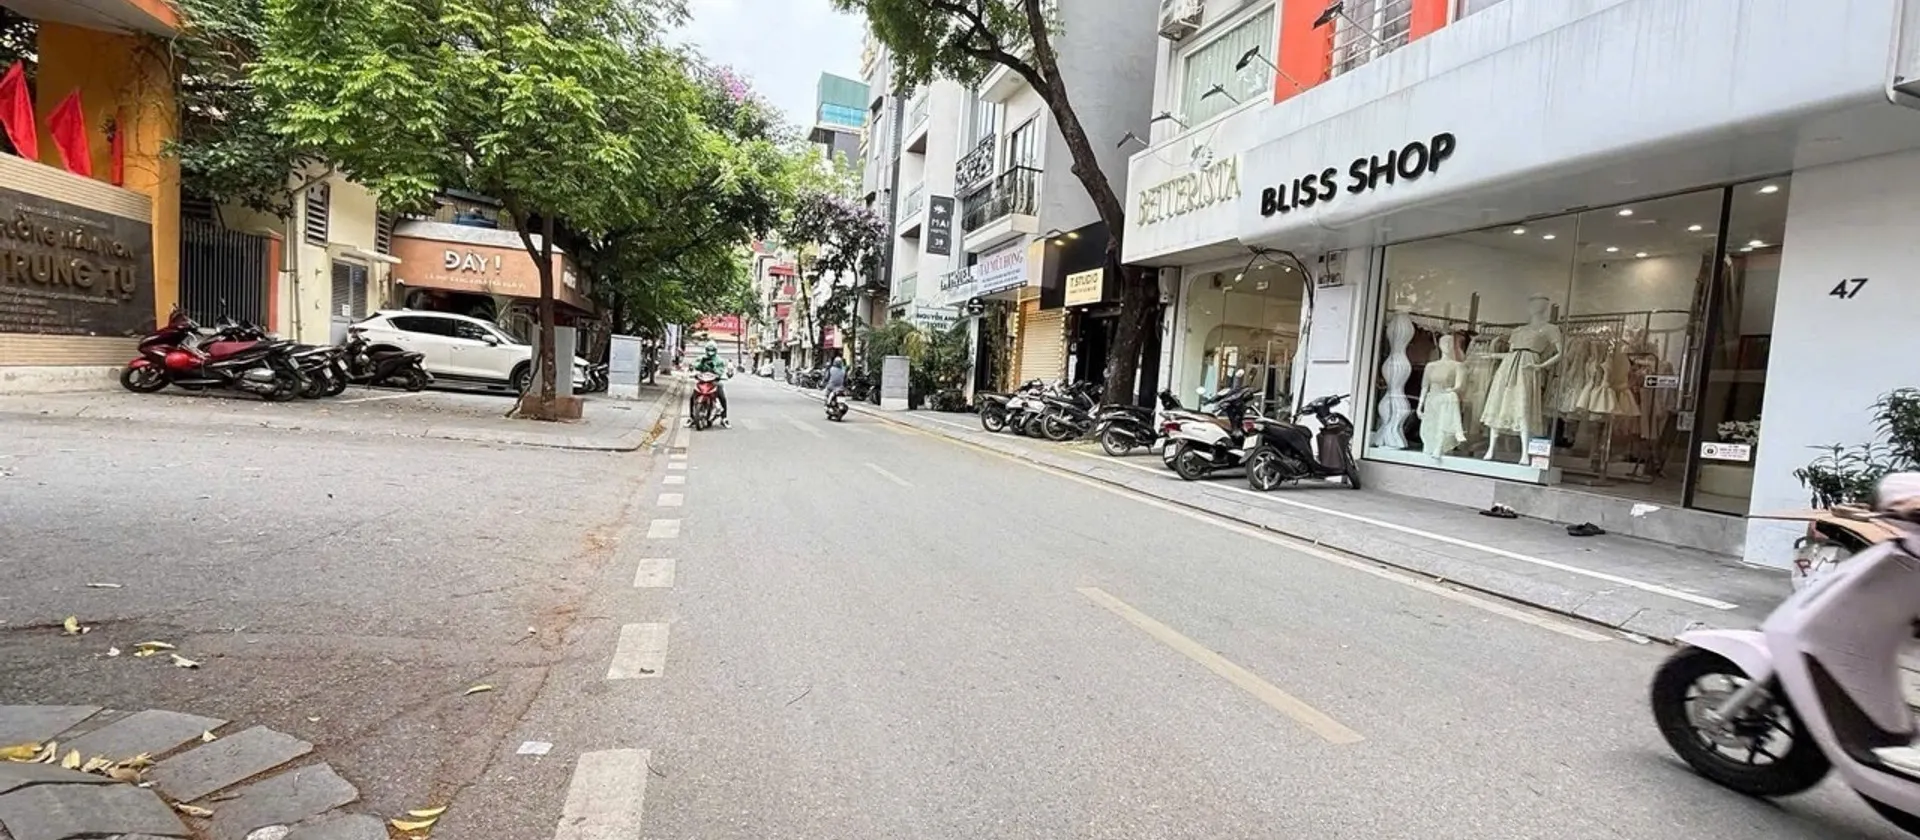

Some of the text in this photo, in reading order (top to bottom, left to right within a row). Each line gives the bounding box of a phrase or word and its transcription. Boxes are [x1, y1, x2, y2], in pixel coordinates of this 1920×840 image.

[1137, 154, 1241, 226] BETTERISTA
[1259, 132, 1457, 218] BLISS SHOP
[931, 218, 950, 228] MAI
[1828, 277, 1869, 300] 47
